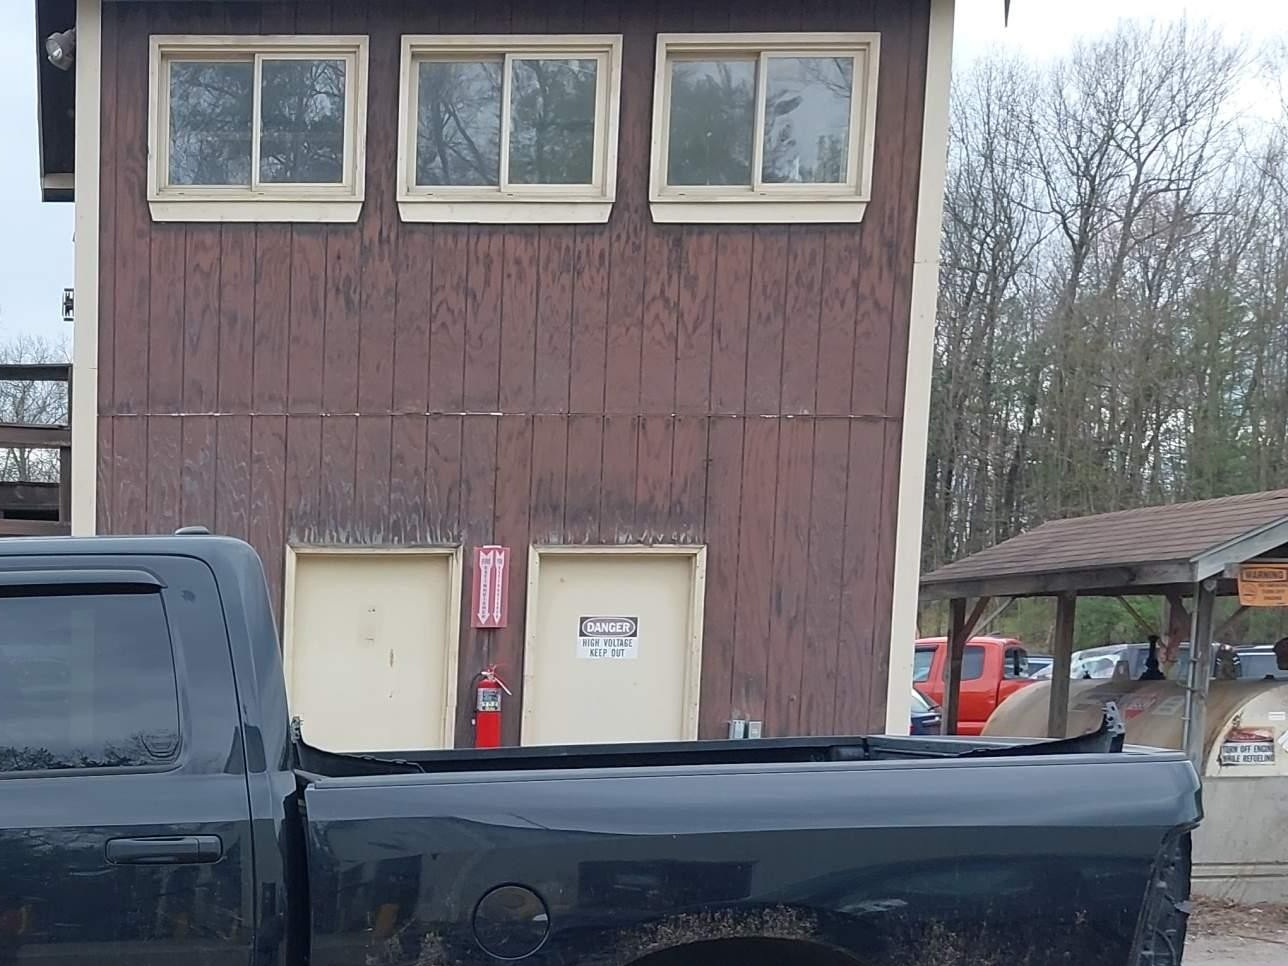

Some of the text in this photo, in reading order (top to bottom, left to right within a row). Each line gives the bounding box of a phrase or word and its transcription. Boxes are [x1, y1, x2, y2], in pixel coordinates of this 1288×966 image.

[586, 622, 631, 633] DANGER
[582, 638, 633, 648] HIGH VOLTAGE
[589, 648, 625, 657] KEEP OUT
[1239, 745, 1251, 753] OFF
